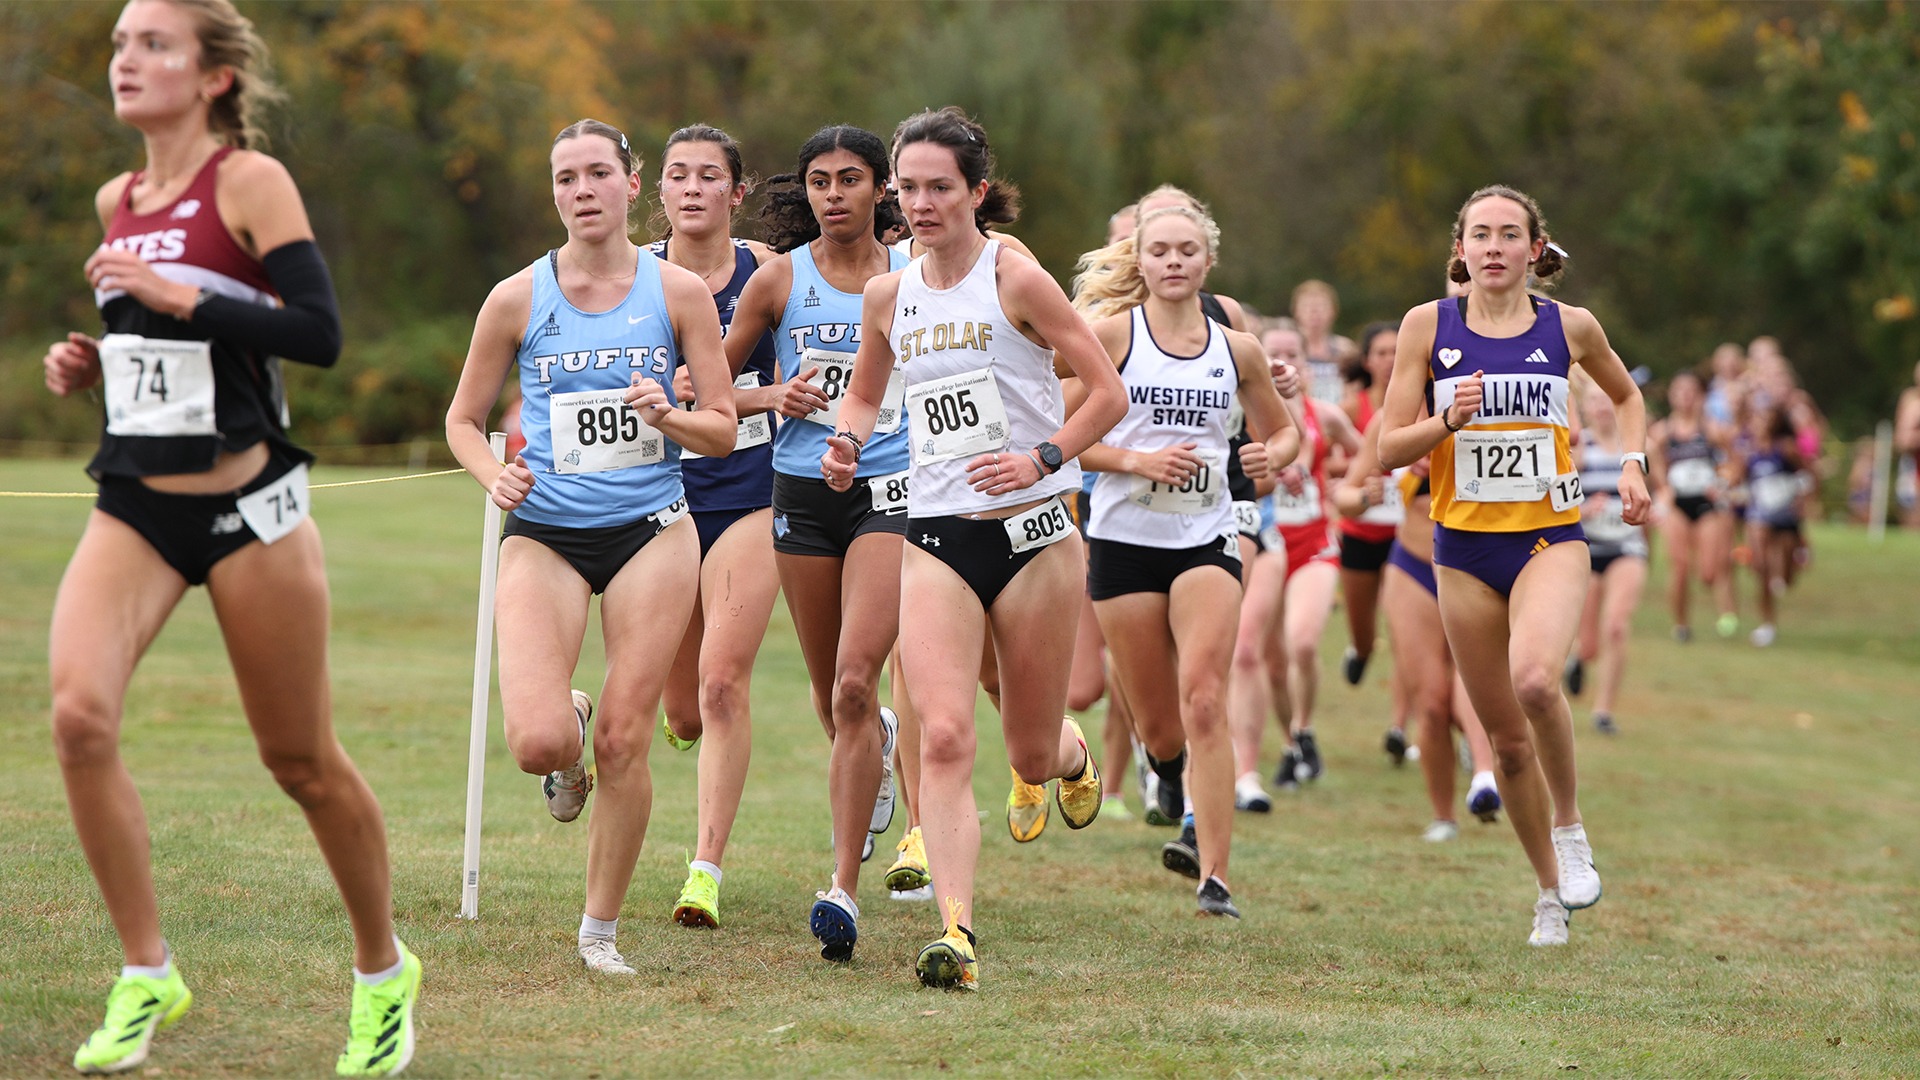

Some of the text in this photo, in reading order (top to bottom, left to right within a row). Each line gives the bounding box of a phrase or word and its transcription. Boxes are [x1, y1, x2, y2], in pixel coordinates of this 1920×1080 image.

[900, 321, 993, 363] ST. OLAF
[534, 345, 669, 383] TUFTS
[806, 355, 844, 365] Connecticut
[129, 356, 168, 403] 74
[935, 381, 955, 395] College
[955, 375, 988, 389] Invitational
[555, 397, 620, 408] Connecticut College
[924, 389, 979, 436] 805
[1130, 386, 1230, 409] WESTFIELD
[577, 405, 639, 446] 895
[1153, 408, 1208, 427] STATE
[1495, 436, 1516, 444] College
[1471, 444, 1539, 478] 1221
[266, 485, 299, 525] 74
[1023, 505, 1066, 542] 805
